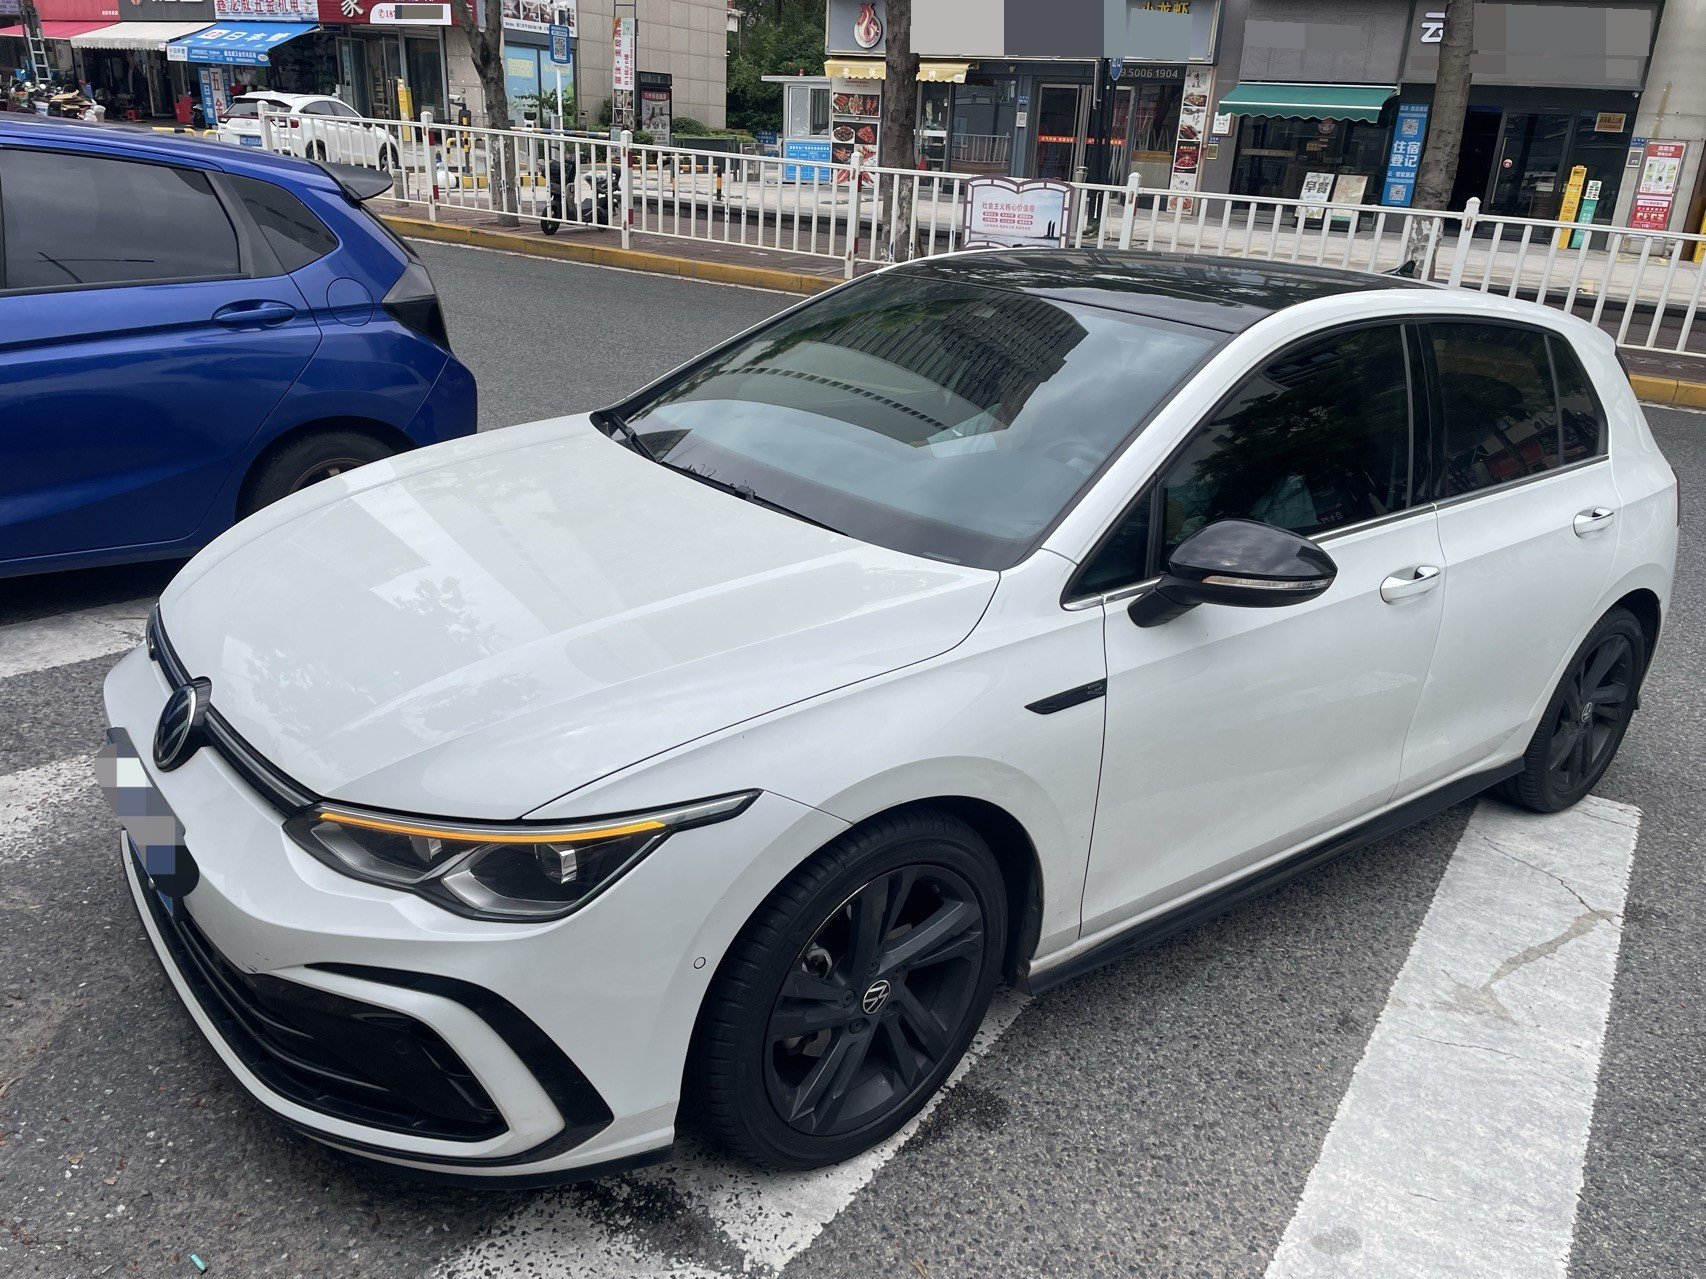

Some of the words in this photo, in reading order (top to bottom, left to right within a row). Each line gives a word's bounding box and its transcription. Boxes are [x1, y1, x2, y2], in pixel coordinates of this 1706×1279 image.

[1128, 68, 1153, 78] 5006
[1155, 69, 1178, 78] 1904
[1393, 141, 1422, 154] 住宿
[1390, 154, 1418, 168] 登记
[1304, 181, 1330, 194] 早餐
[982, 202, 1036, 212] 社会主义核心价值观
